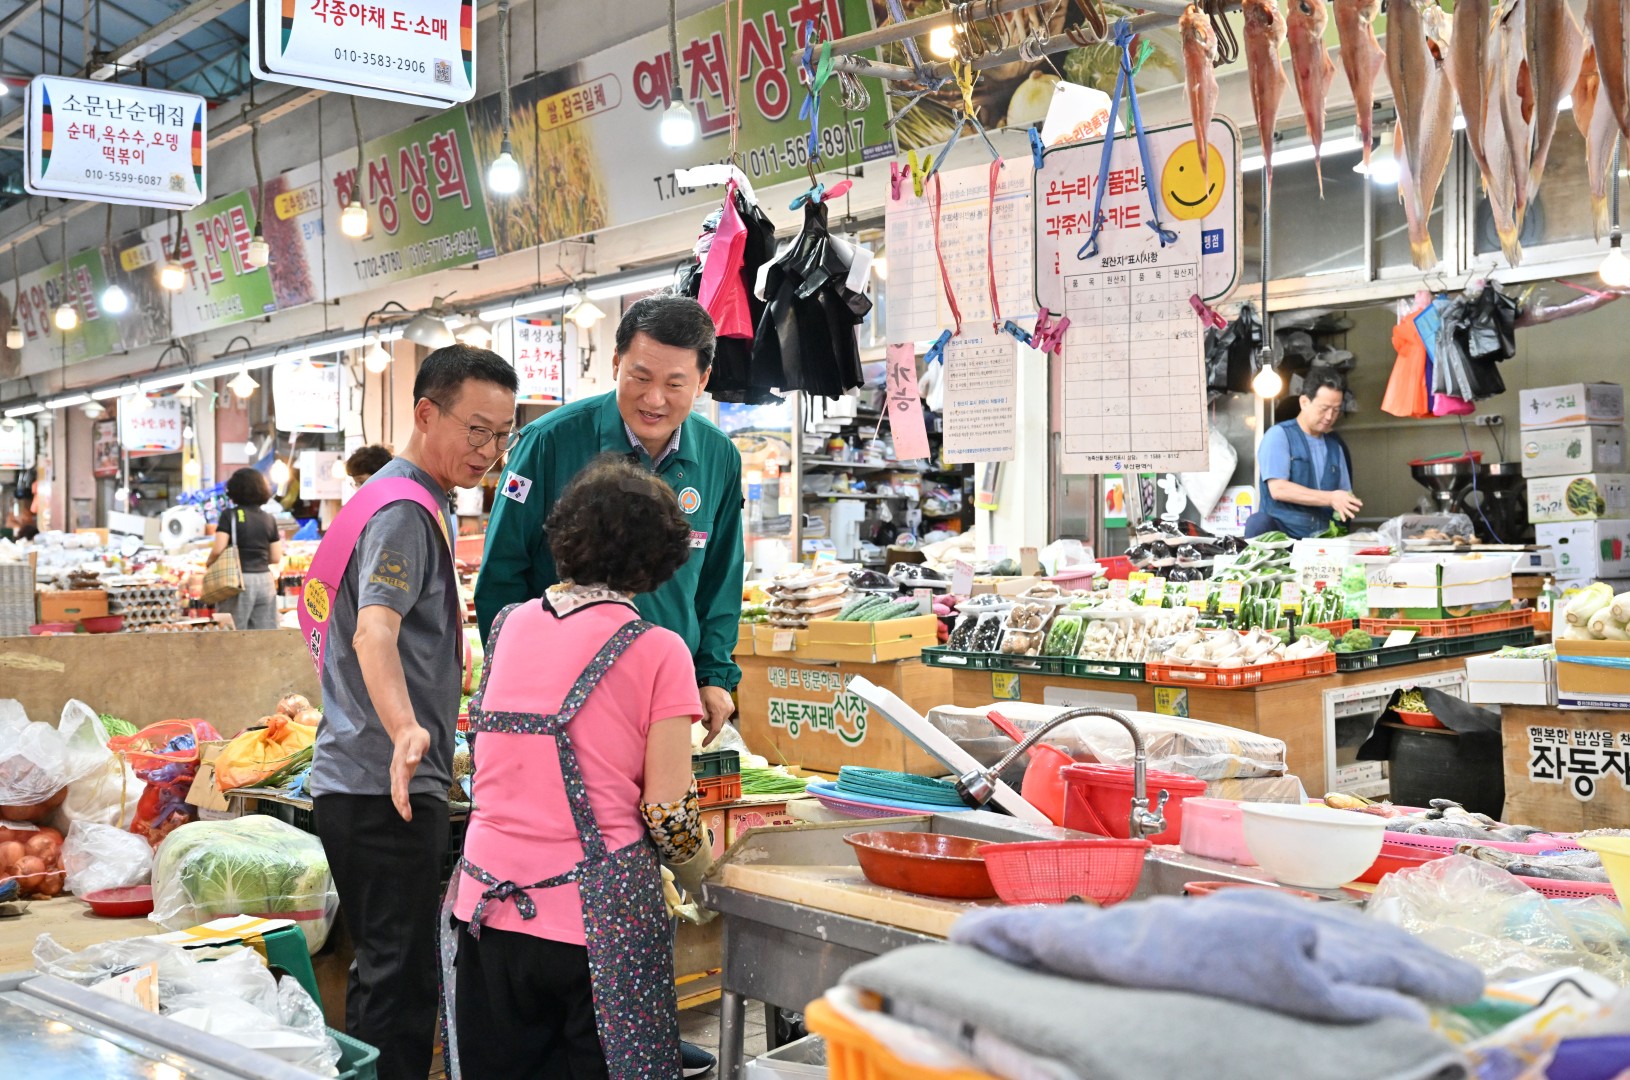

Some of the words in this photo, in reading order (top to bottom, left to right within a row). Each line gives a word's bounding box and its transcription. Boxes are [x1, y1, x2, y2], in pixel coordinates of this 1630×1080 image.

[310, 0, 386, 30] 각종야채
[390, 10, 448, 42] 도·소매
[333, 47, 427, 75] 010-3583-2906
[61, 93, 185, 127] 소문난순대집
[544, 82, 607, 126] 쌀,잡곡일체
[66, 121, 179, 152] 순대,옥수수,오뎅
[102, 145, 146, 166] 떡볶이
[84, 168, 162, 186] 010-5599-6087
[1045, 165, 1140, 206] 온누리품권
[1101, 255, 1124, 268] 원산지
[1127, 252, 1158, 265] 표시사항
[1123, 463, 1153, 471] 부산광역시
[369, 574, 411, 593] KOREA
[768, 668, 788, 687] 내일
[790, 669, 799, 684] 또
[801, 671, 842, 692] 방문하고
[770, 695, 867, 736] 좌동재래시장
[1530, 727, 1568, 745] 행복한
[1574, 730, 1614, 748] 밥상을
